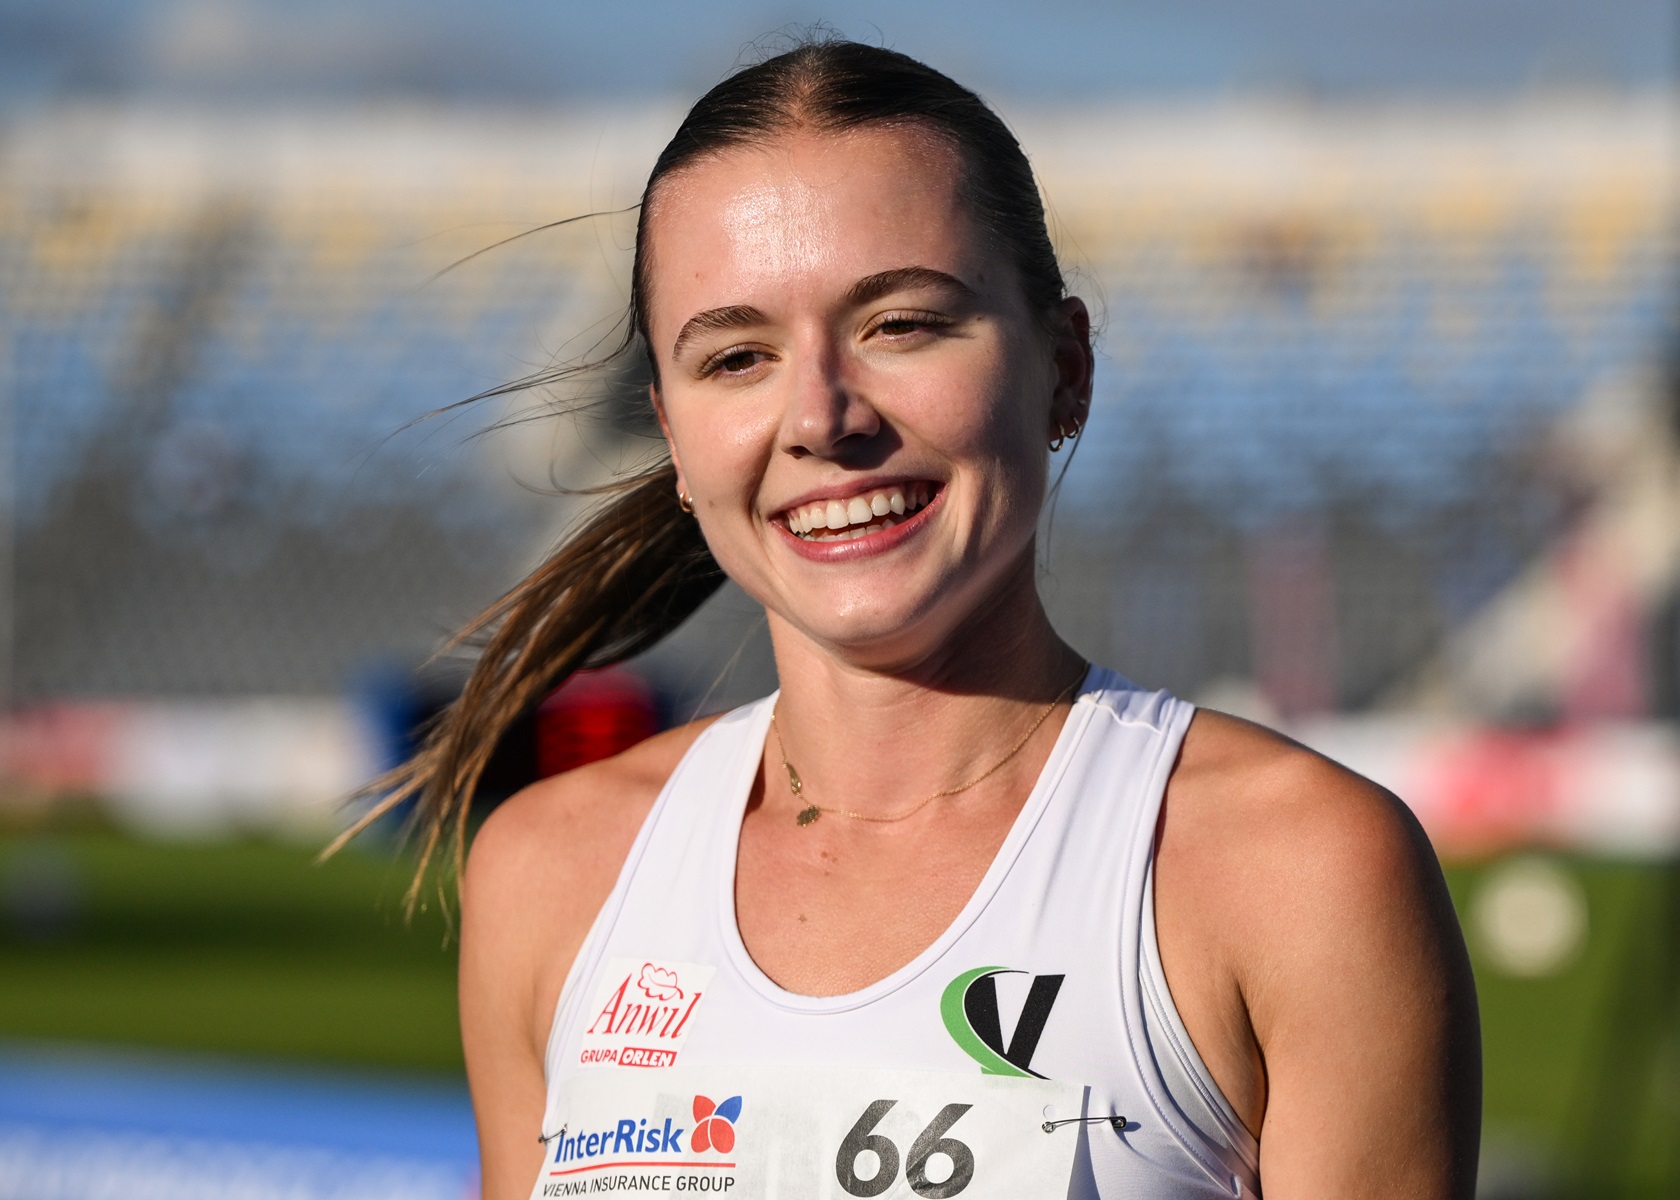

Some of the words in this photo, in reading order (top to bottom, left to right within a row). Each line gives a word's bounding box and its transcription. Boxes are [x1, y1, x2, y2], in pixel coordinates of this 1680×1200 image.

[587, 972, 702, 1040] Anwil
[580, 1048, 618, 1064] GRUPA
[621, 1048, 674, 1067] ORLEN
[554, 1118, 684, 1163] InterRisk
[835, 1099, 975, 1199] 66
[543, 1181, 587, 1198] VIENNA
[590, 1175, 671, 1193] INSURANCE
[676, 1175, 735, 1193] GROUP
